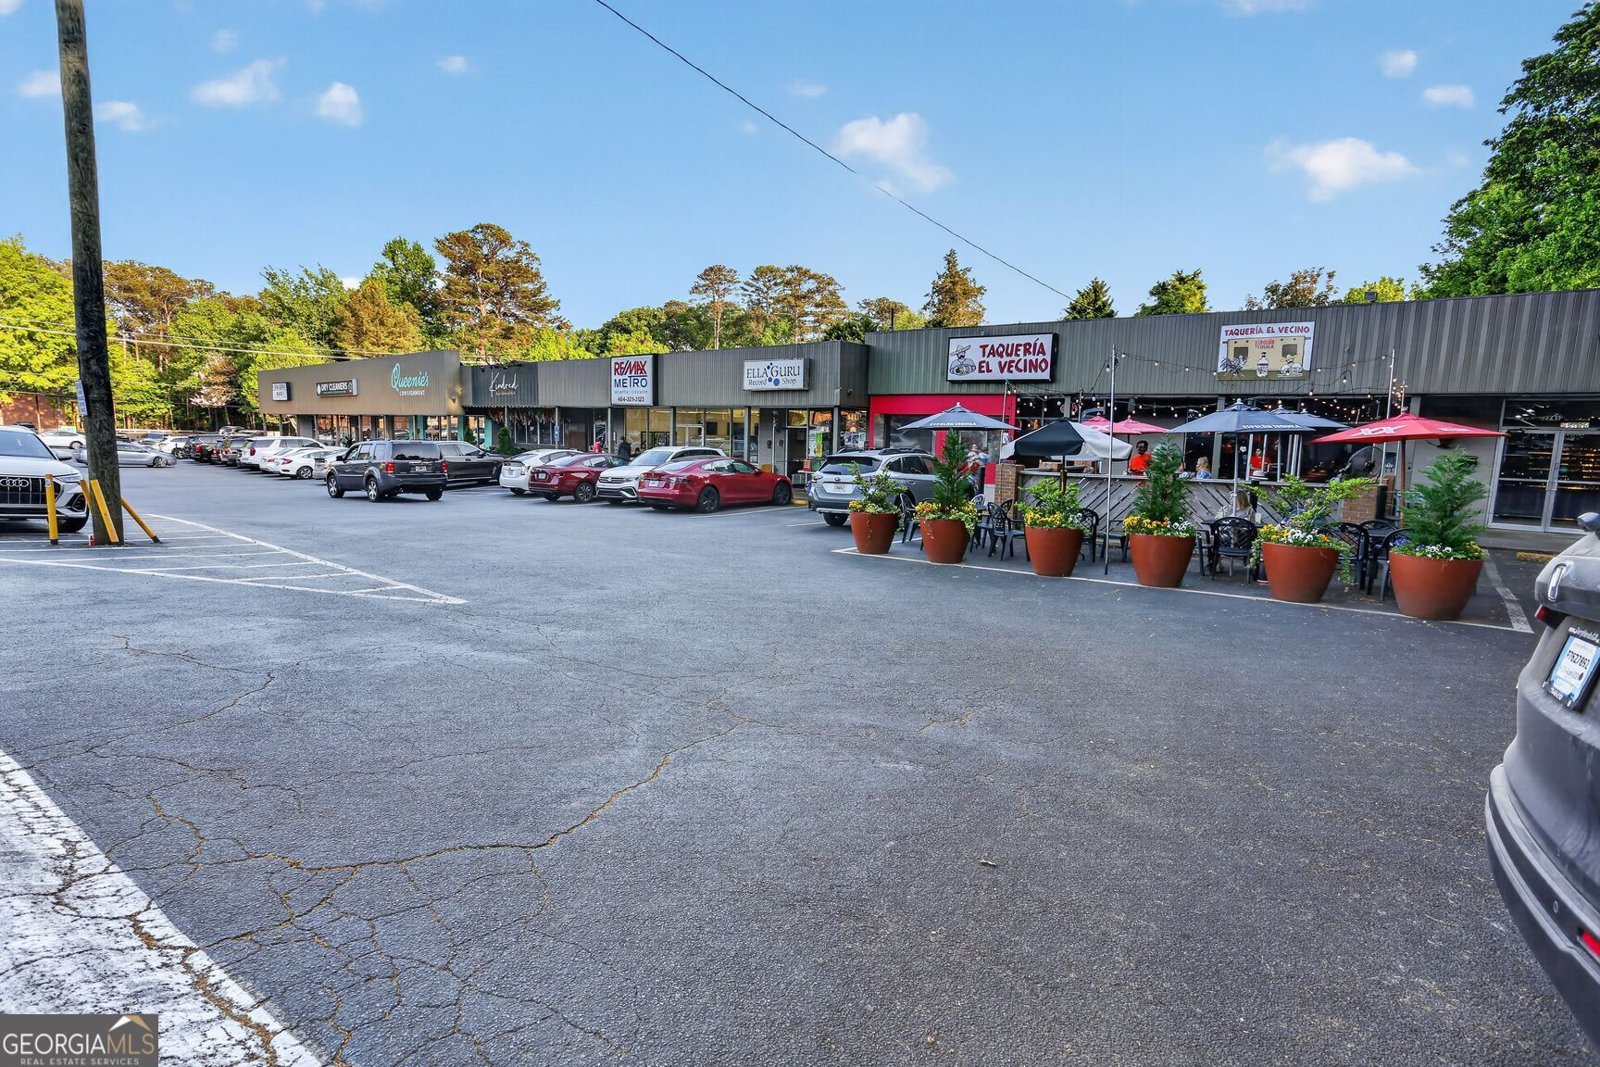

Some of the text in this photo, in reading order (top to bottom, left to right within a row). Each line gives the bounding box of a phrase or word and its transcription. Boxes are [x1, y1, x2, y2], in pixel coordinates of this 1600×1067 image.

[1224, 325, 1310, 336] TAQUERÍA EL VECINO
[979, 337, 1046, 359] TAQUERÍA
[614, 360, 647, 376] RE/MAX
[746, 367, 769, 378] ELLA
[978, 357, 1049, 374] EL VECINO
[391, 362, 429, 391] Queenie's
[614, 375, 648, 388] METRO
[781, 377, 797, 386] Shop
[329, 382, 348, 390] CLEANERS
[489, 371, 519, 397] Kindred
